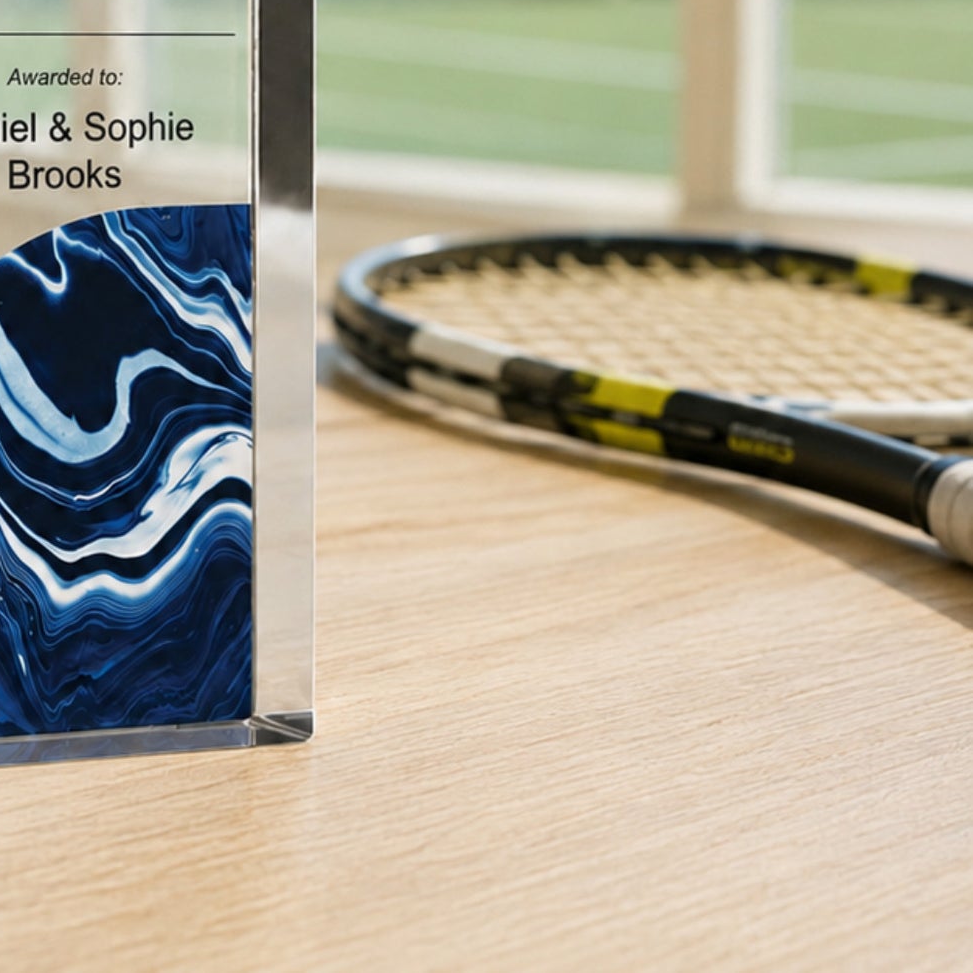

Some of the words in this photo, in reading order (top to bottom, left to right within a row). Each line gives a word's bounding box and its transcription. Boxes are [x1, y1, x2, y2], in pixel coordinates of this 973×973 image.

[6, 67, 93, 87] Awarded
[98, 70, 124, 87] to:
[48, 112, 73, 143] &
[84, 111, 195, 148] Sophie
[8, 159, 122, 190] Brooks
